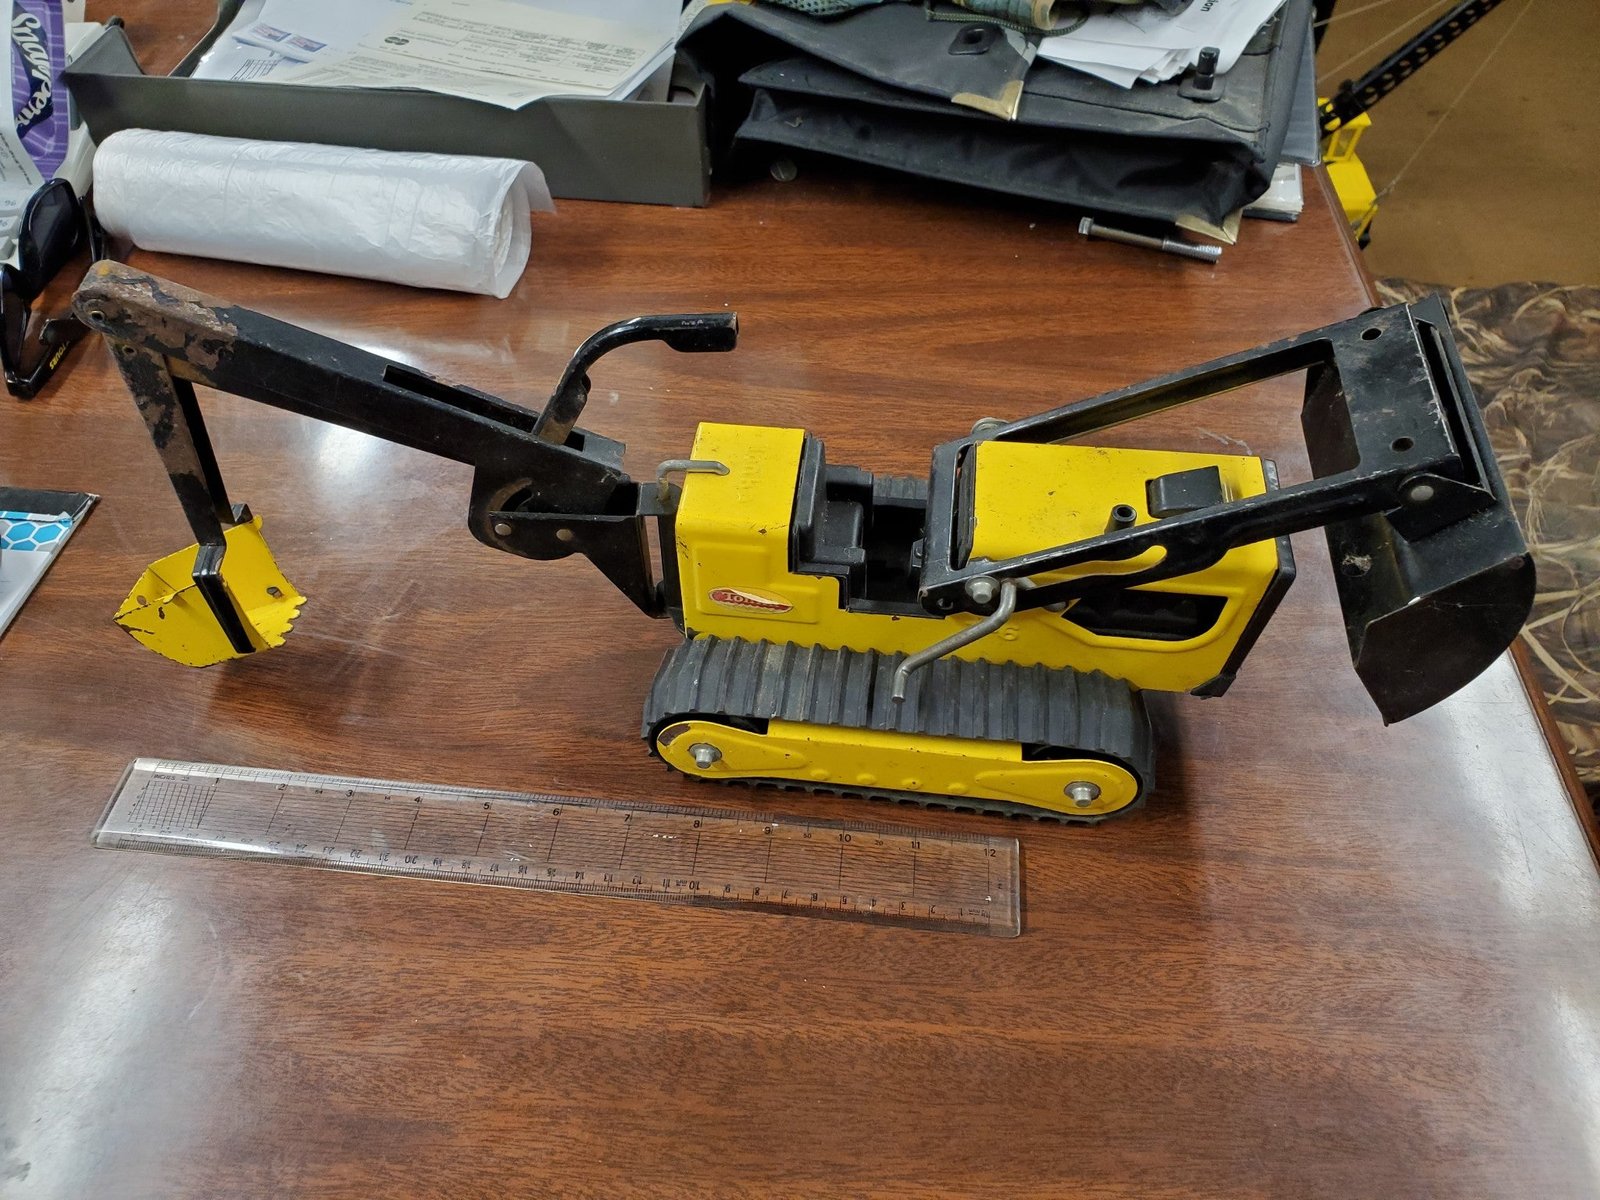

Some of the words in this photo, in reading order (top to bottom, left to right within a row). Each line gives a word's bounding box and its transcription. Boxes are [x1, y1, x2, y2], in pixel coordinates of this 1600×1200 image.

[277, 783, 286, 791] 2
[346, 789, 354, 797] 3
[483, 801, 490, 810] 5
[552, 808, 560, 816] 6
[624, 813, 631, 822] 7
[693, 820, 700, 828] 8
[764, 826, 771, 834] 9
[838, 833, 852, 842] 10
[911, 840, 921, 849] 11
[984, 848, 997, 858] 12
[323, 846, 335, 855] 23
[350, 849, 362, 858] 22
[404, 855, 418, 864] 20
[490, 862, 499, 872] 17
[575, 870, 585, 880] 14
[604, 872, 613, 882] 13
[632, 875, 642, 884] 12
[689, 880, 700, 890] 10
[724, 884, 731, 893] 9
[754, 886, 761, 896] 8
